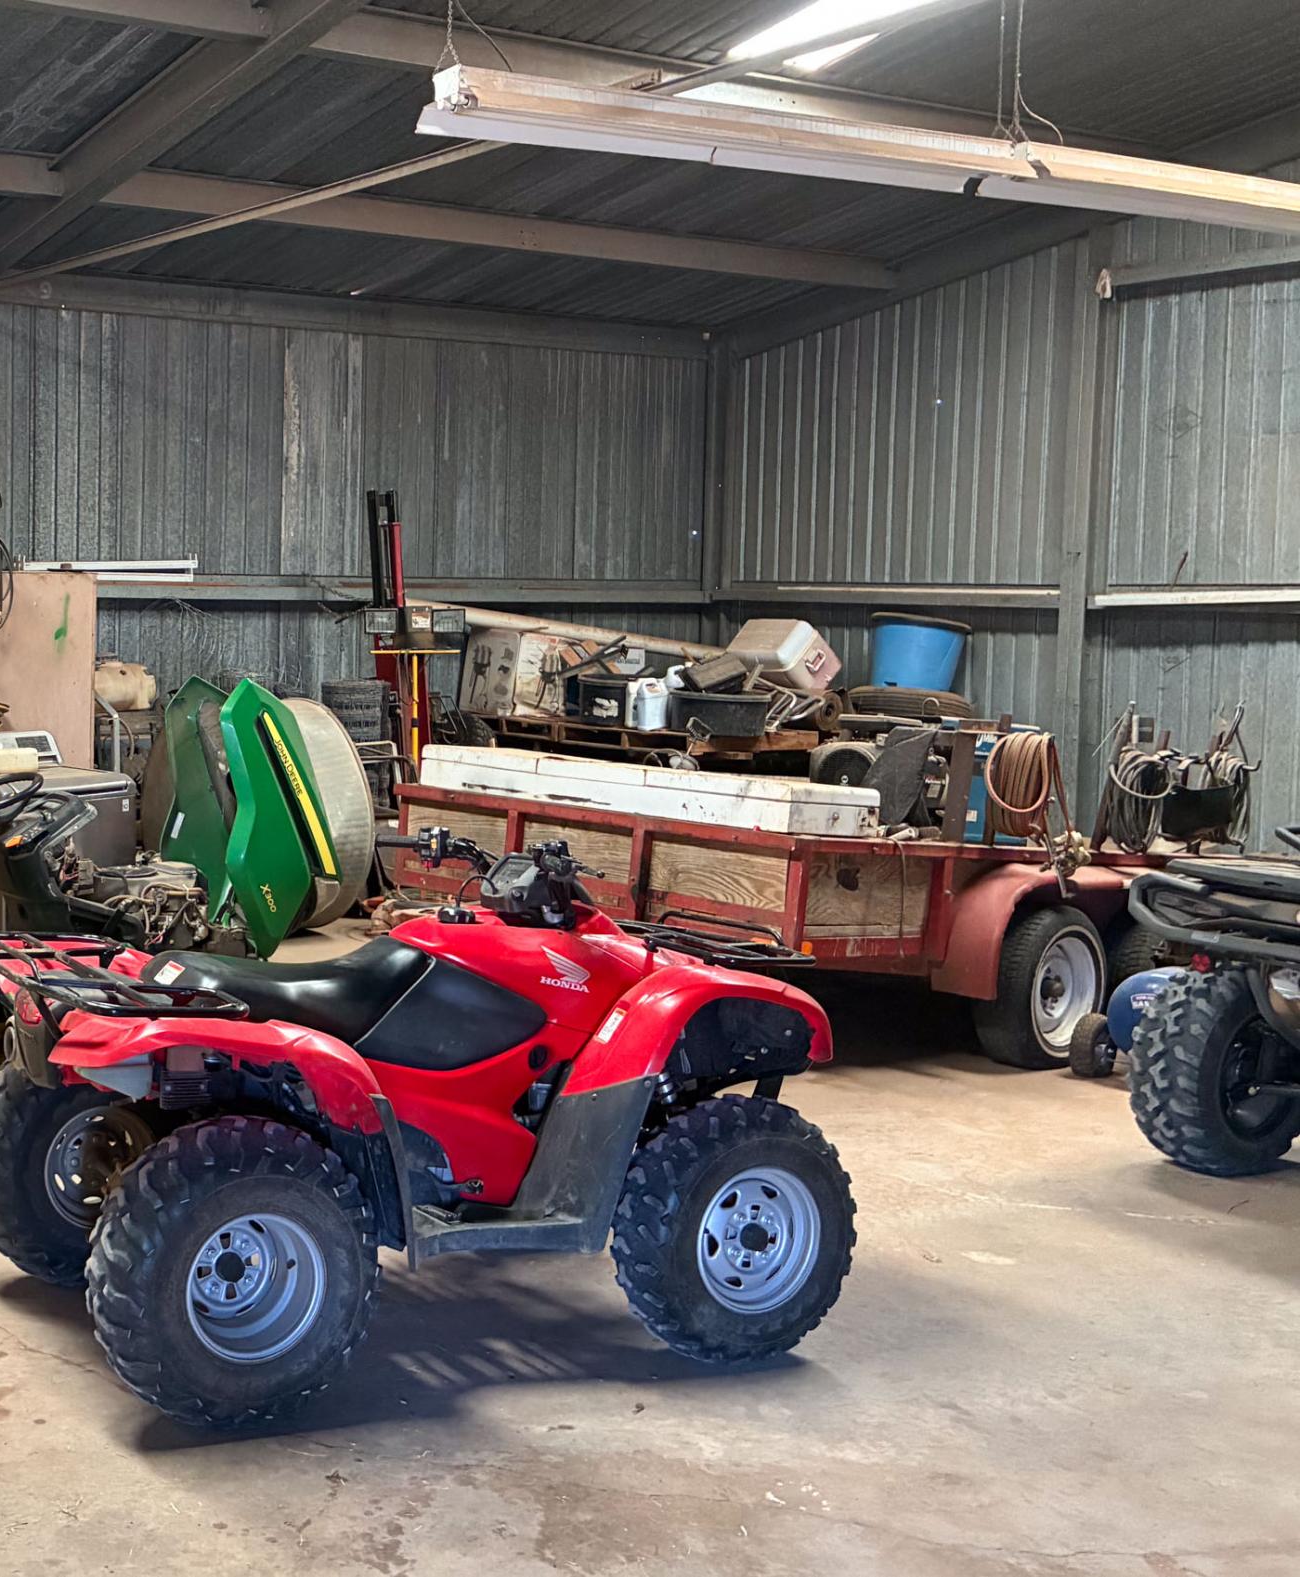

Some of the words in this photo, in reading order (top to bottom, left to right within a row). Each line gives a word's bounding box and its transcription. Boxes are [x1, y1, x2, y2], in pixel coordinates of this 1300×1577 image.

[275, 740, 289, 764] JOHN
[286, 764, 303, 796] DEERE
[260, 884, 276, 912] X300
[540, 976, 590, 993] HONDA
